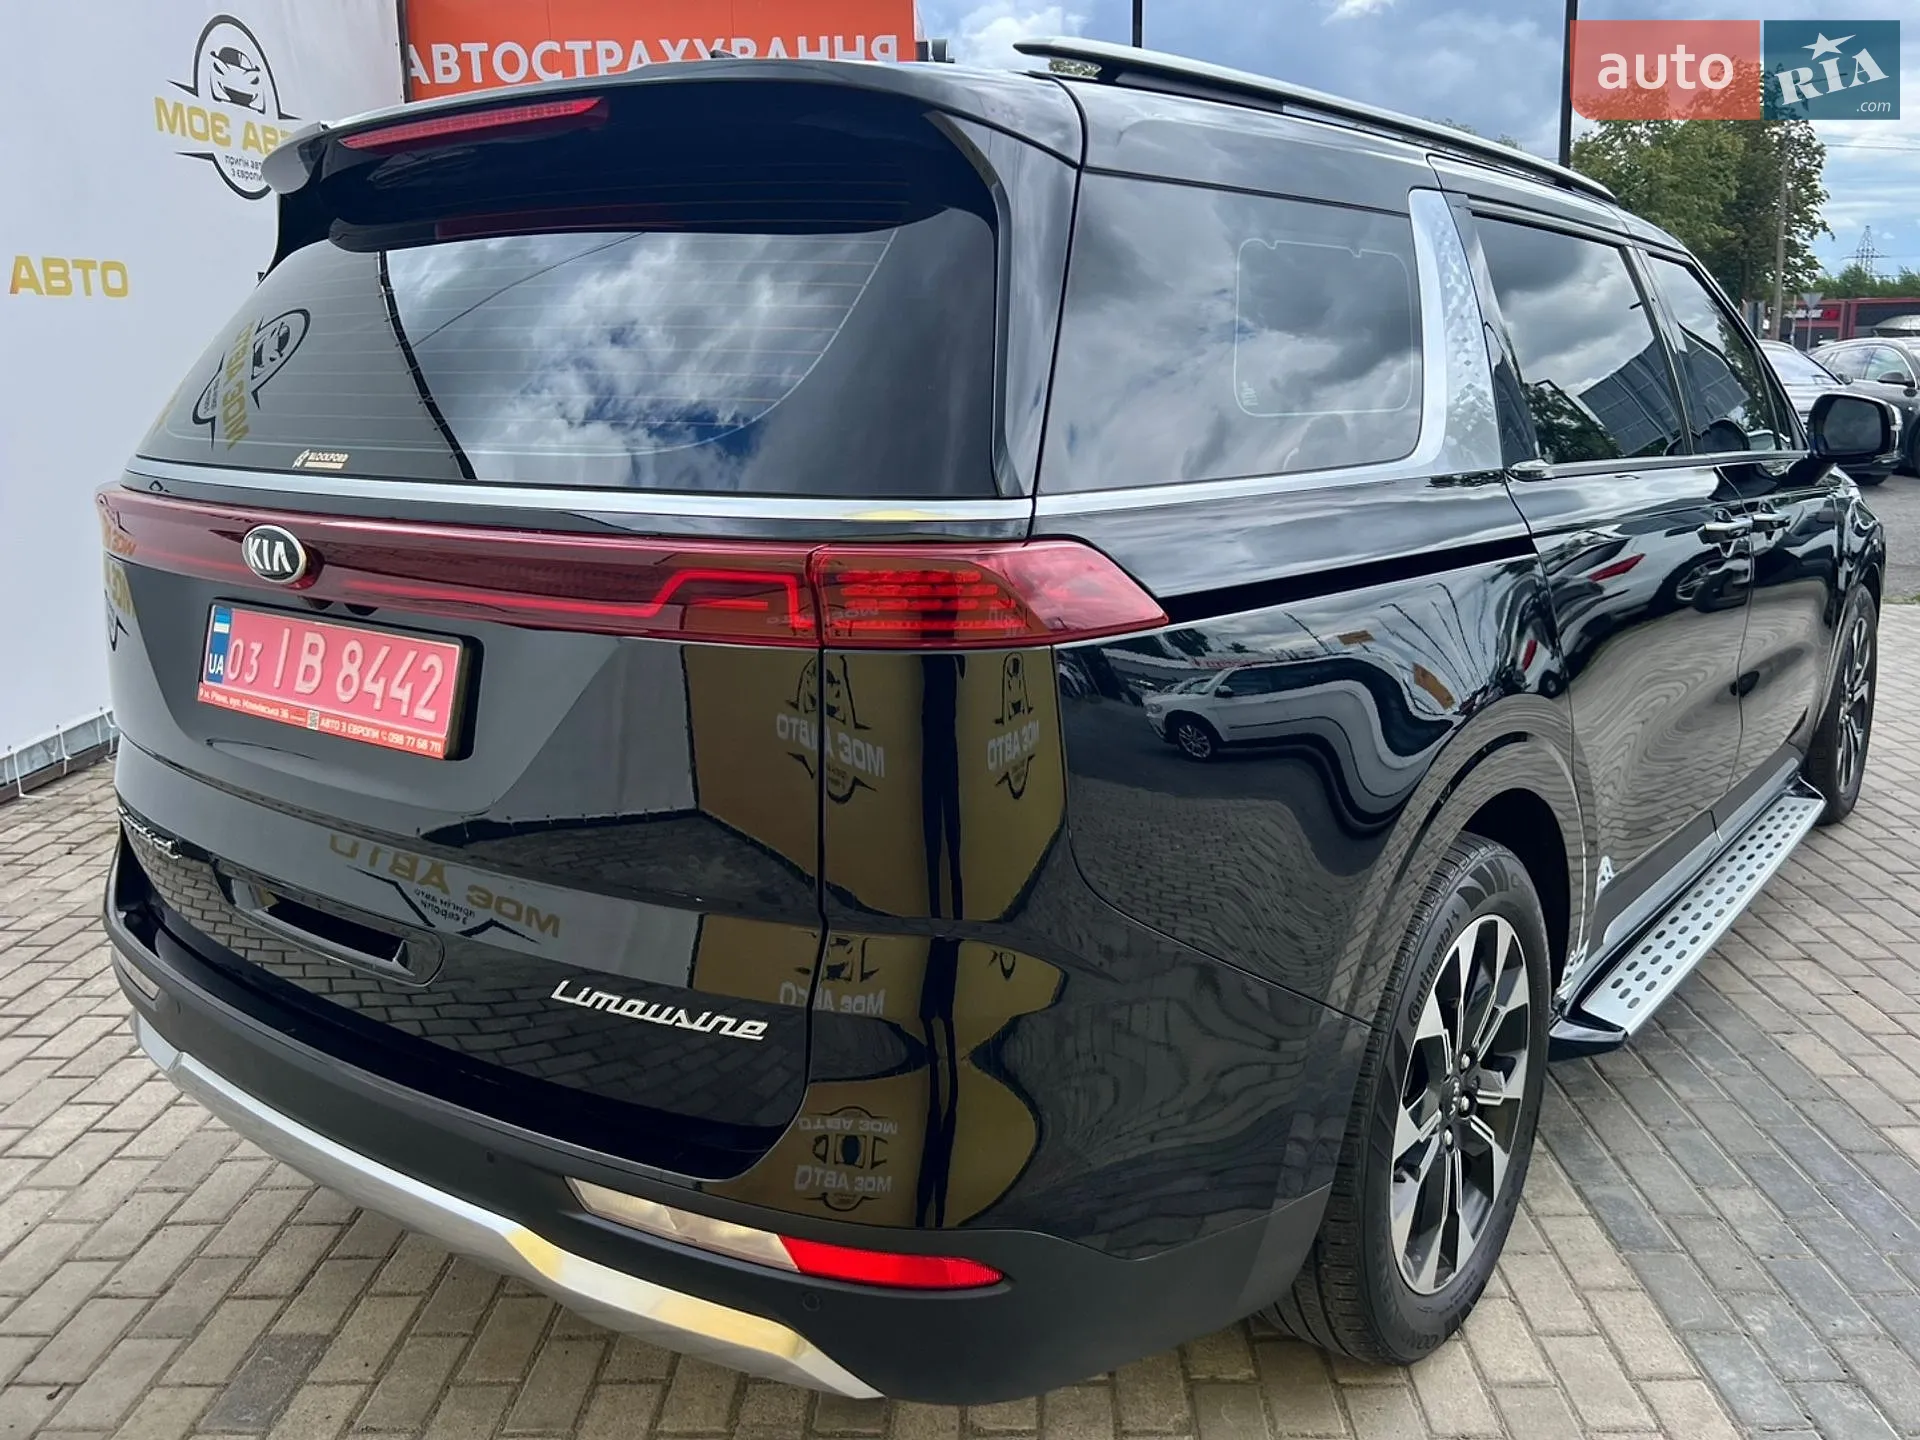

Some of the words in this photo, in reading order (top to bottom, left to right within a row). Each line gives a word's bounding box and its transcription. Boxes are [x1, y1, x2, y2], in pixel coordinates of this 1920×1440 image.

[155, 97, 232, 147] МОЄ
[242, 120, 294, 156] АВ
[10, 255, 128, 297] АВТО
[248, 536, 294, 573] KIA
[208, 653, 224, 675] UA
[227, 638, 263, 684] 03
[335, 639, 444, 723] 8442
[551, 980, 769, 1041] Limousine
